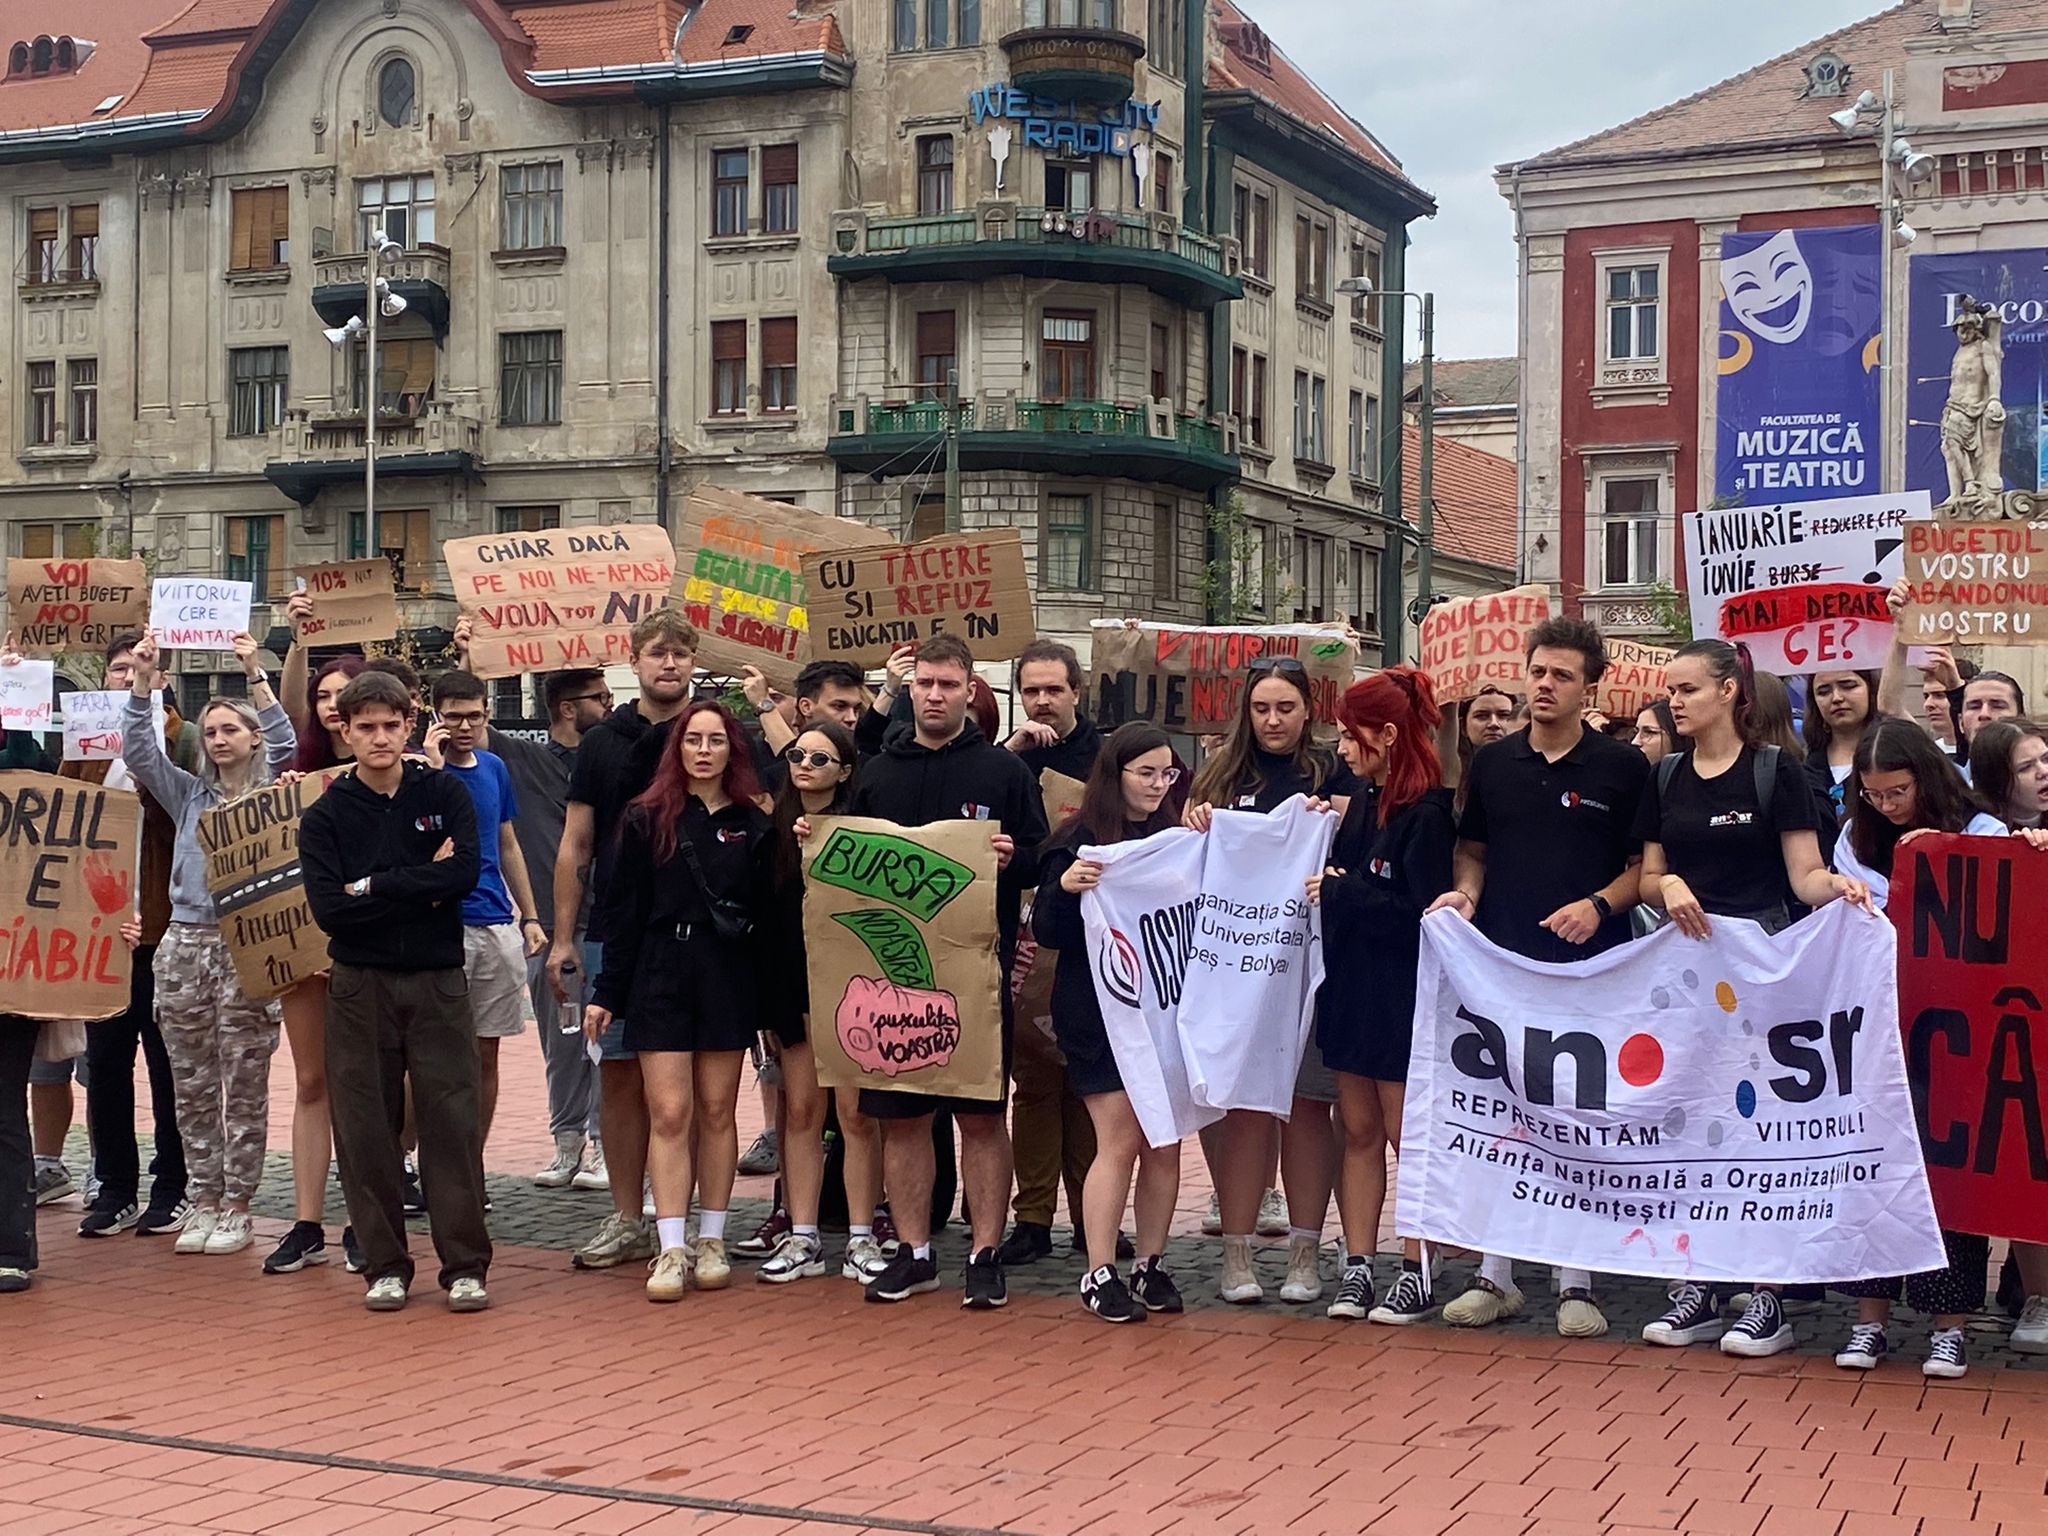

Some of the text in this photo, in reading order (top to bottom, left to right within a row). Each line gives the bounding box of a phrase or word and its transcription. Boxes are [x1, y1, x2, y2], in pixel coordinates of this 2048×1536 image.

[1025, 119, 1131, 157] RADIO
[1760, 413, 1841, 426] FACULTATEA DE
[1736, 421, 1865, 457] MUZICĂ
[1742, 459, 1865, 489] TEATRU
[478, 530, 630, 563] CHIAR DACĂ
[1910, 526, 2044, 553] BUGETUL
[42, 561, 88, 587] VOI
[311, 570, 347, 592] 10%
[472, 558, 672, 594] PE NOI NE-APASĂ
[820, 559, 855, 589] CU
[1769, 563, 1822, 586] BURSE
[1921, 553, 2030, 580] VOSTRU
[80, 585, 134, 604] BUGET
[159, 584, 241, 601] VIITORUL
[895, 580, 993, 616] REFUZ
[34, 604, 94, 625] NOI
[178, 606, 218, 621] CERE
[560, 605, 595, 620] TOT
[963, 612, 998, 638] ÎN
[1728, 599, 1779, 631] MAI
[1919, 611, 2031, 635] NOSTRU
[20, 624, 71, 645] AVEM
[1784, 620, 1860, 665] CE?
[507, 642, 543, 667] NU
[558, 634, 591, 660] VĂ
[1485, 661, 1521, 681] CEI
[26, 854, 68, 909] E
[821, 835, 956, 911] BURSA
[1913, 852, 2012, 964] NU
[854, 910, 933, 986] NOASTRĂ
[265, 954, 294, 986] în
[1451, 1089, 1865, 1146] REPREZENTĂM VIITORUL!
[1448, 1133, 1881, 1193] Alianța Națională a Organizațiilor
[1512, 1180, 1833, 1224] Studențești din România
